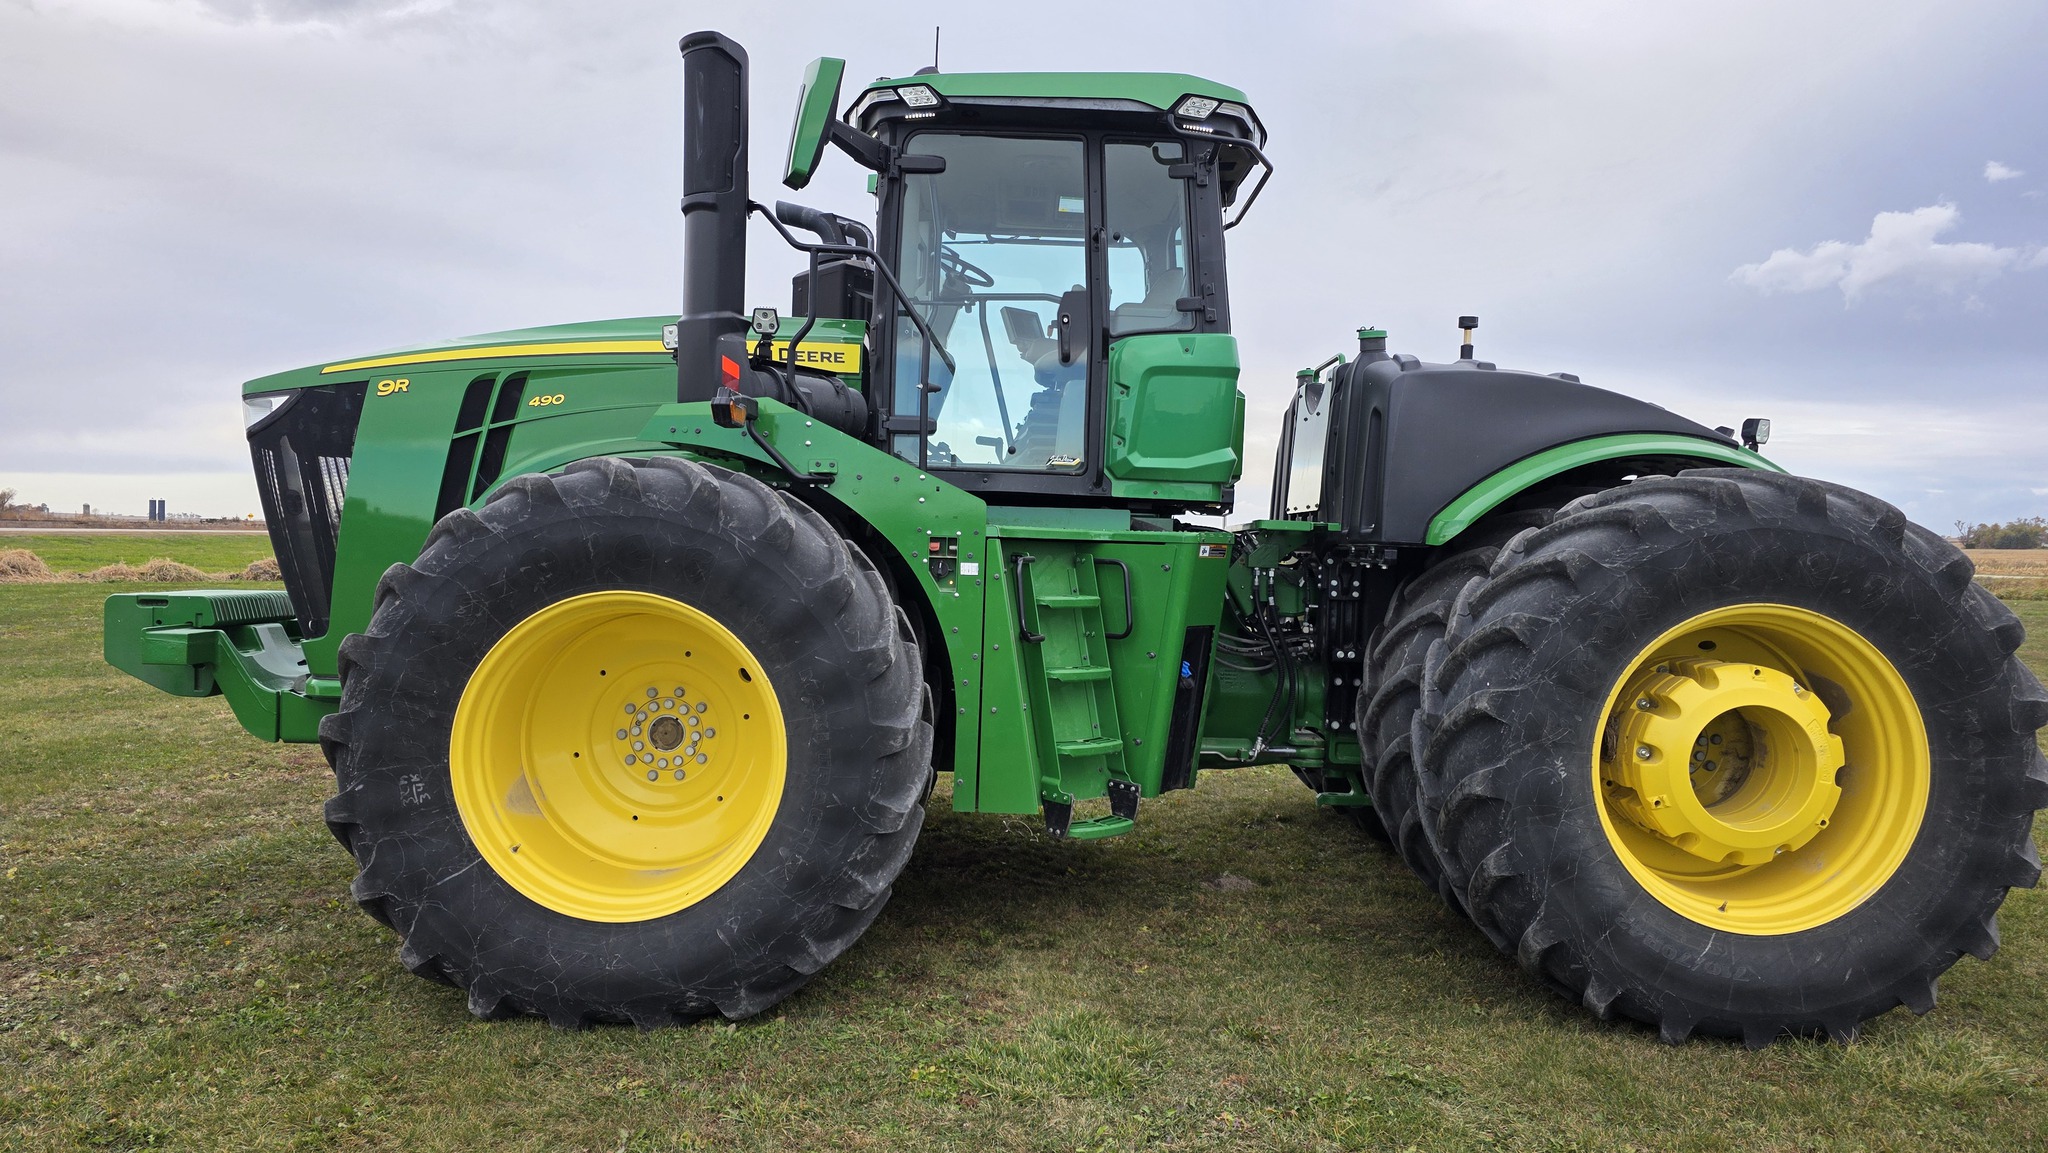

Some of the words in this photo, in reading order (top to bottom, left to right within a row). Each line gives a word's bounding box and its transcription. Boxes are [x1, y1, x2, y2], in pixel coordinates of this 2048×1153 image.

[778, 347, 846, 364] DEERE
[377, 379, 410, 397] 9R
[528, 393, 566, 408] 490
